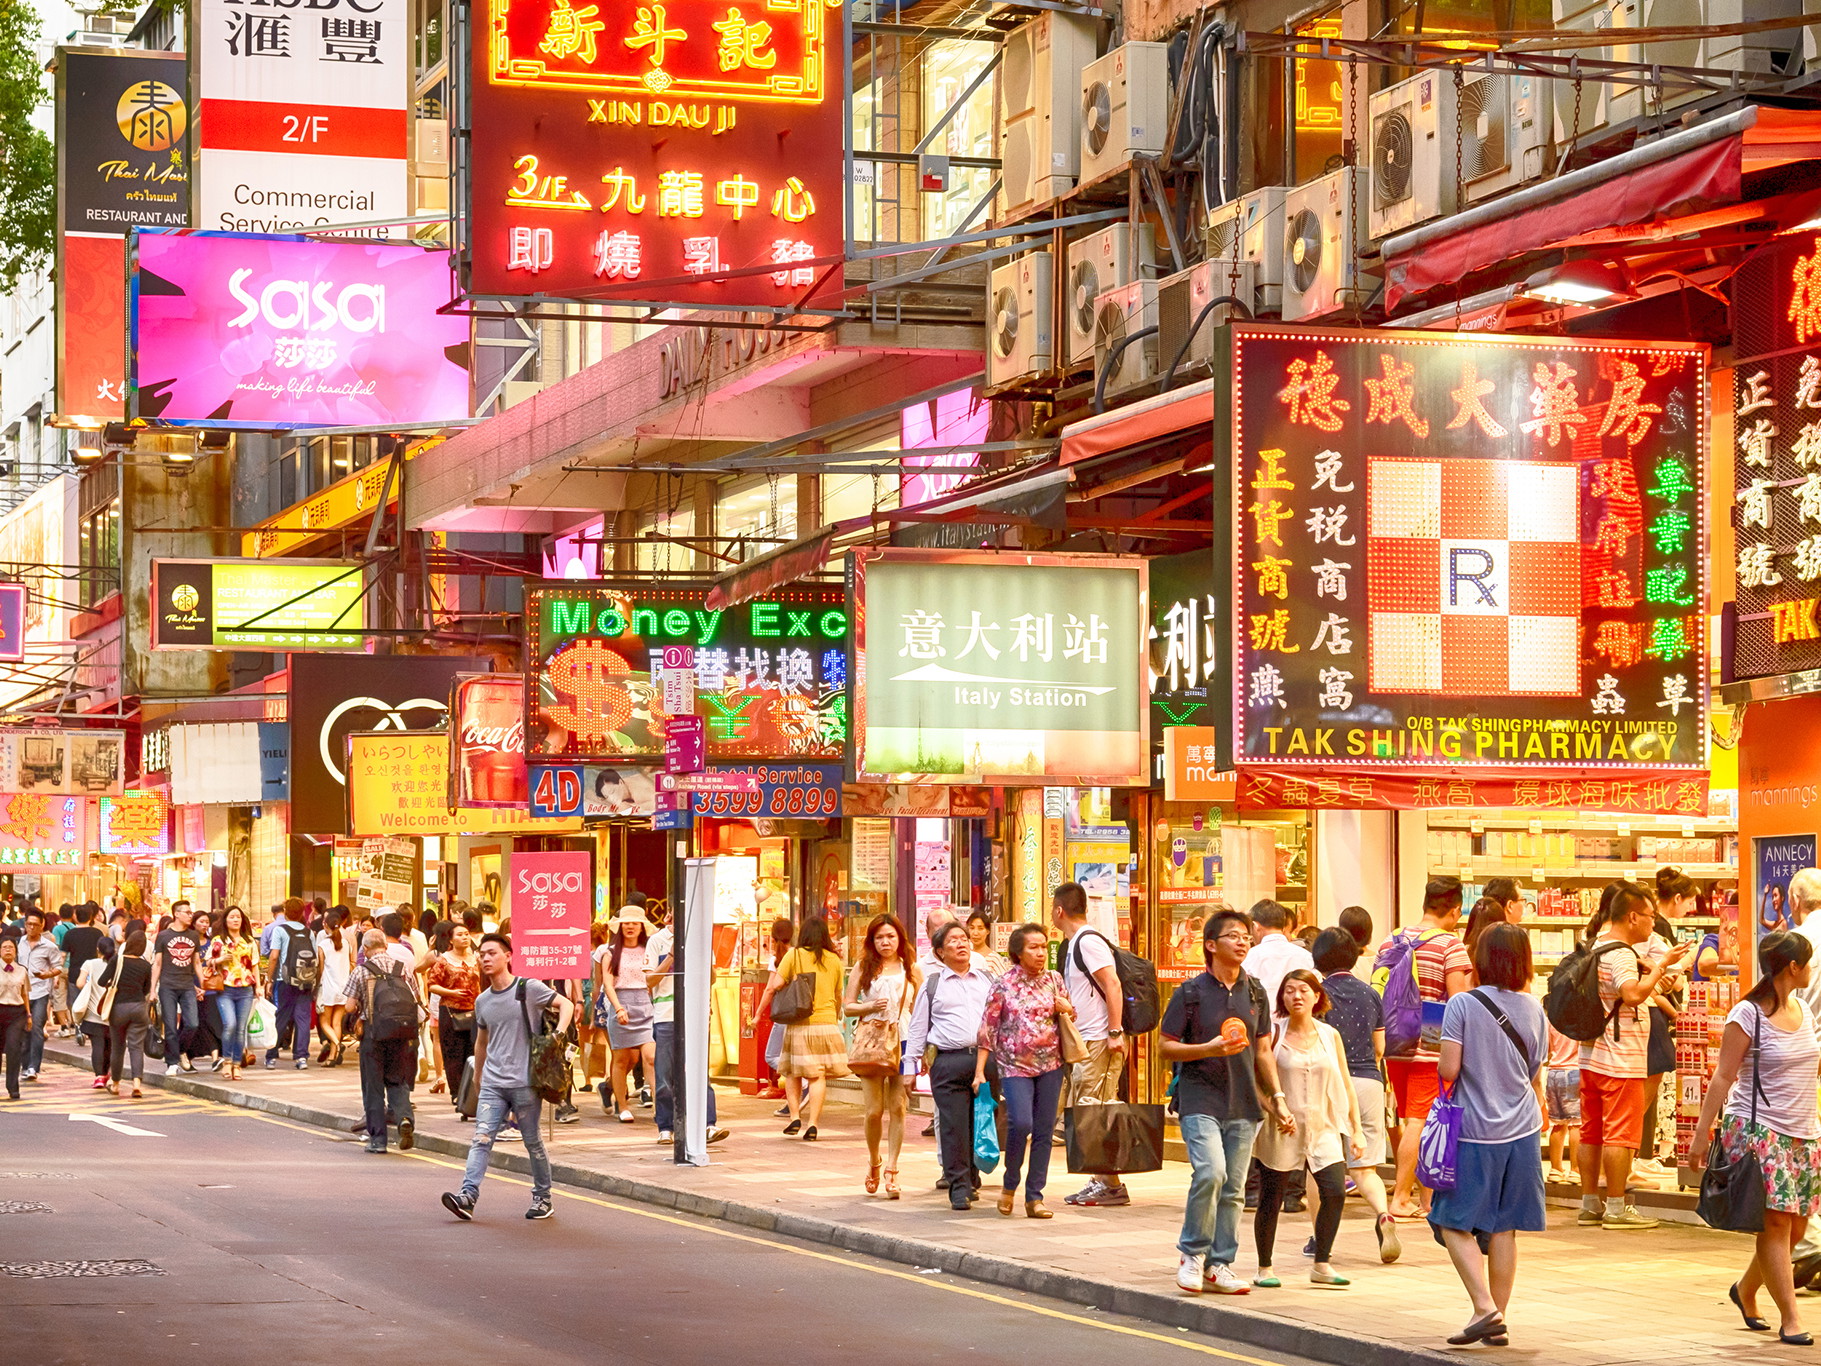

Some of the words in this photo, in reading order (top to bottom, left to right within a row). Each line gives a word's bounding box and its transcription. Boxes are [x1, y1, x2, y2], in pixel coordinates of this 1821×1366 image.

[539, 2, 777, 72] 新斗記
[282, 115, 329, 143] 2/F
[587, 99, 641, 125] XIN
[648, 101, 710, 128] DAU
[711, 105, 737, 135] JI
[97, 159, 139, 182] Thai
[234, 184, 374, 211] Commercial
[507, 154, 568, 201] 3/F
[600, 166, 815, 223] 九龍中心
[86, 209, 162, 223] RESTAURANT
[164, 212, 187, 224] AND
[506, 226, 816, 288] 即燒乳豬
[275, 336, 337, 370] 莎莎
[236, 377, 286, 399] making
[287, 377, 314, 399] life
[316, 378, 377, 402] beautiful
[1281, 349, 1663, 448] 德成大藥房
[1248, 448, 1300, 654] 正貨商號
[551, 602, 720, 644] Money
[1768, 598, 1820, 643] TAK
[898, 608, 1111, 665] 意大利站
[674, 671, 682, 693] Tsui
[674, 695, 682, 713] Sha
[955, 686, 1001, 709] Italy
[1009, 686, 1086, 707] Station
[1407, 717, 1432, 731] O/B
[1437, 717, 1468, 732] TAK
[1615, 719, 1678, 735] LIMITED
[1263, 727, 1335, 756] TAK
[1347, 729, 1462, 758] SHING
[1476, 731, 1678, 761] PHARMACY
[757, 766, 823, 784] Service
[534, 769, 582, 813] 4D
[694, 789, 765, 815] 3599
[769, 787, 838, 814] 8899
[1512, 780, 1702, 813] 環球海味批發
[1751, 780, 1818, 808] mannings
[109, 793, 161, 848] 藥
[380, 813, 449, 827] Welcome
[1765, 844, 1813, 862] ANNECY
[532, 894, 566, 918] 莎莎
[1684, 1086, 1694, 1100] 41
